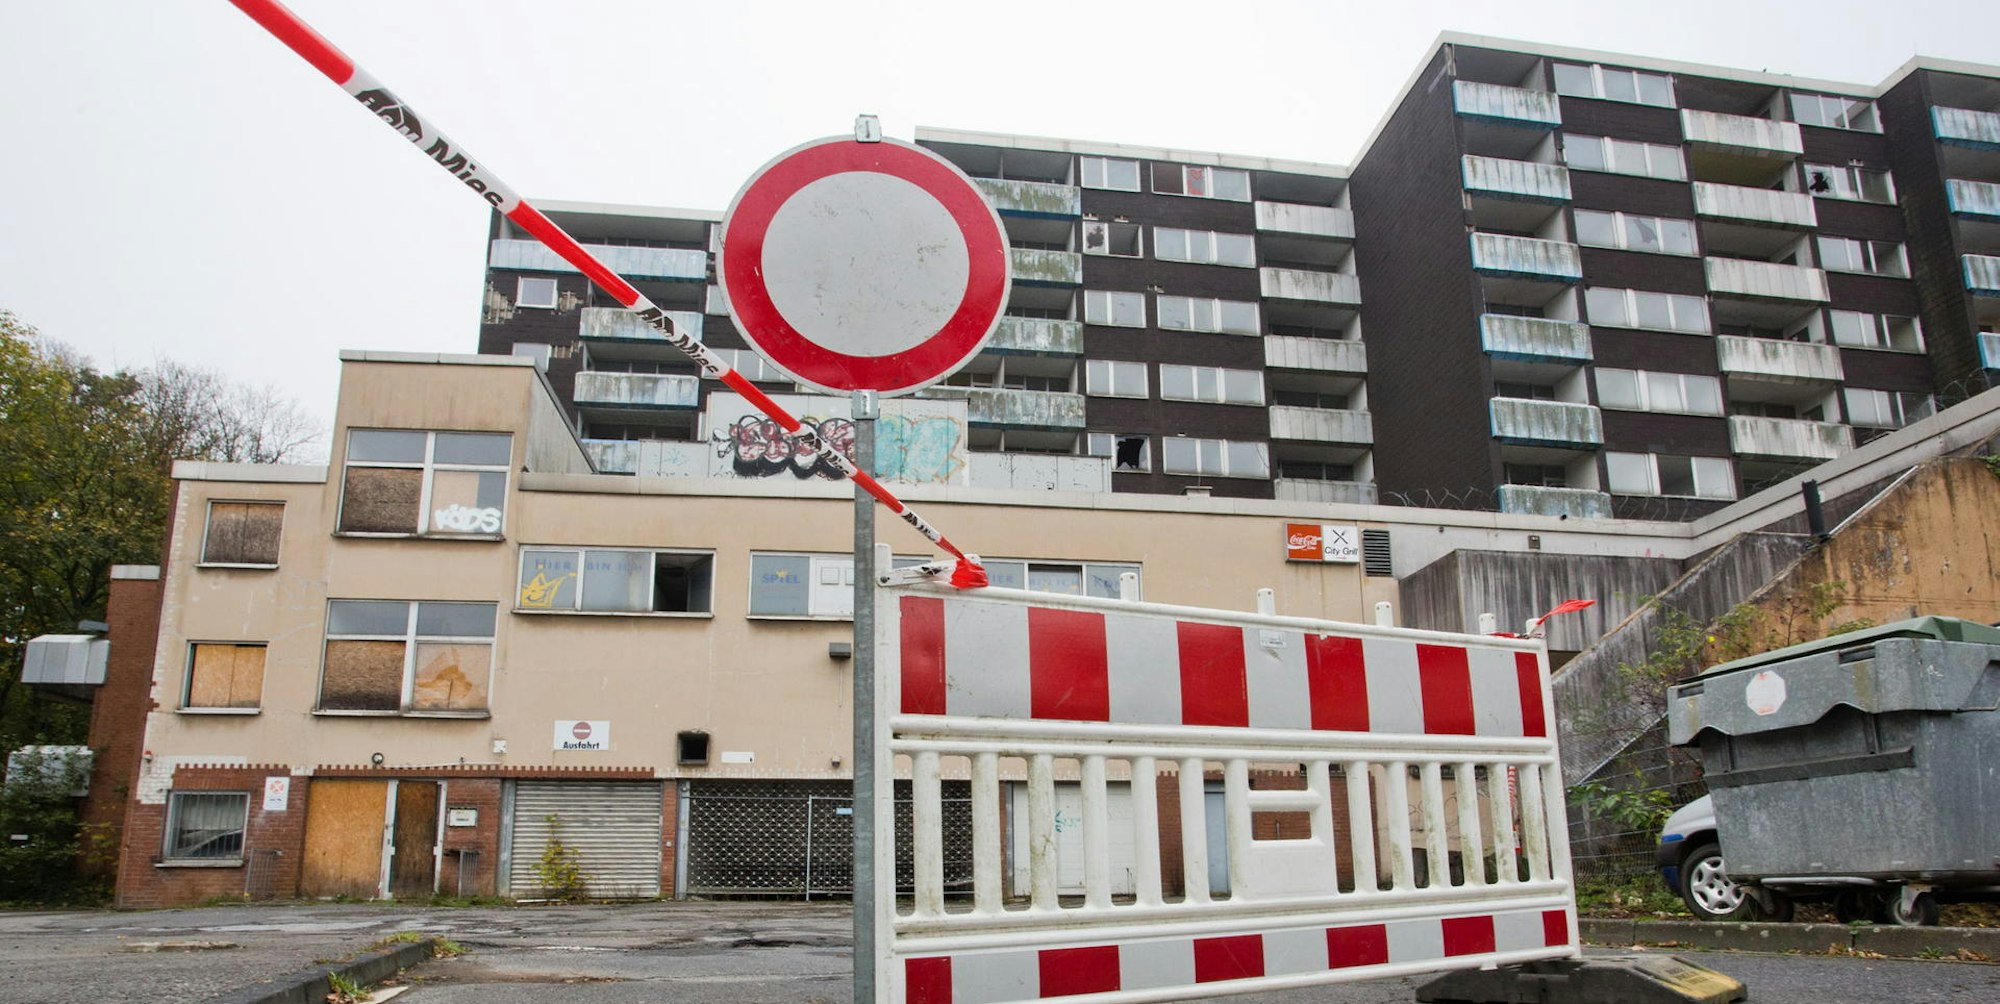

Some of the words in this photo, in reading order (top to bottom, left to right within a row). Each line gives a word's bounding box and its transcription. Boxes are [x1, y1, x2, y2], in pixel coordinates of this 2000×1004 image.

[1324, 546, 1341, 556] City
[1342, 547, 1359, 556] Grill
[989, 574, 1015, 585] IER
[562, 740, 600, 750] Ausfahrt
